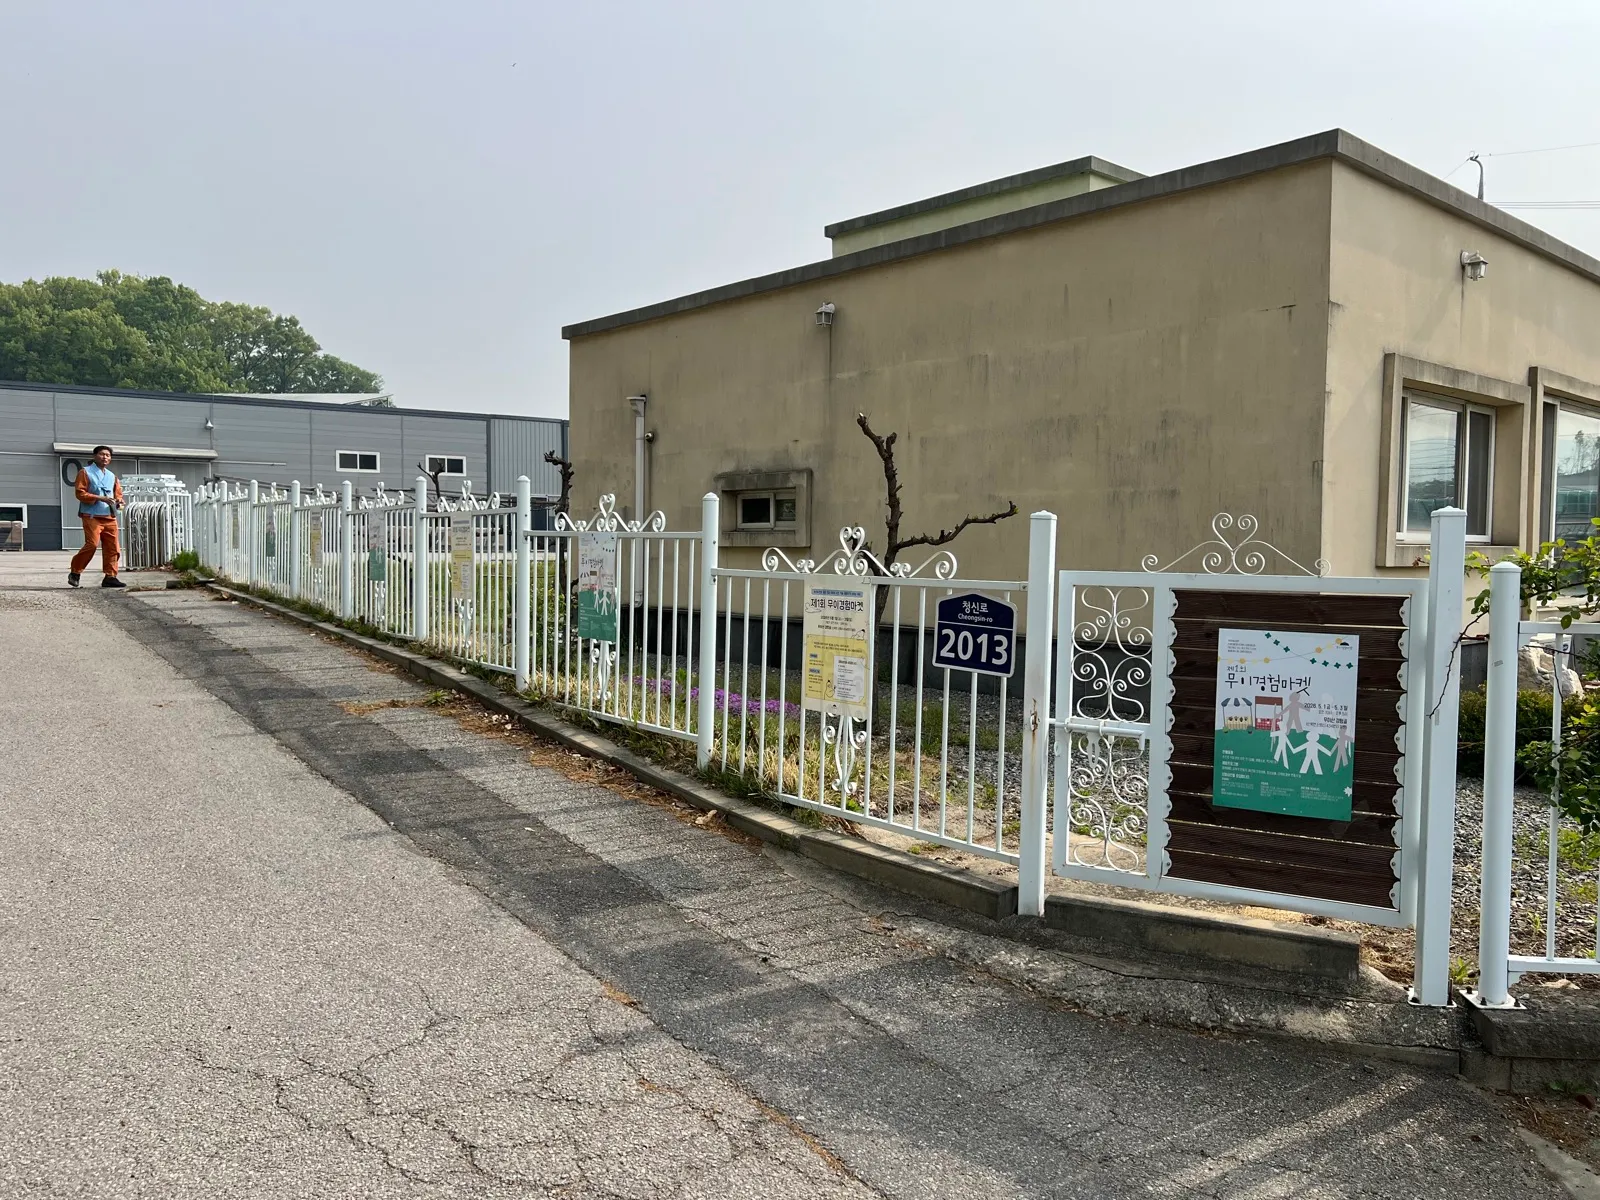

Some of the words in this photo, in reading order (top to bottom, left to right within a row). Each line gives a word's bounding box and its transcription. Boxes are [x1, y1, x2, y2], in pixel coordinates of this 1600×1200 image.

[811, 598, 826, 608] 제1회
[827, 599, 864, 612] 무이경험마켓
[962, 600, 989, 614] 청신로
[957, 613, 993, 623] Cheongsin-ro
[940, 628, 1008, 665] 2013
[1226, 664, 1247, 673] 제1회
[1225, 672, 1311, 697] 무이경험마켓
